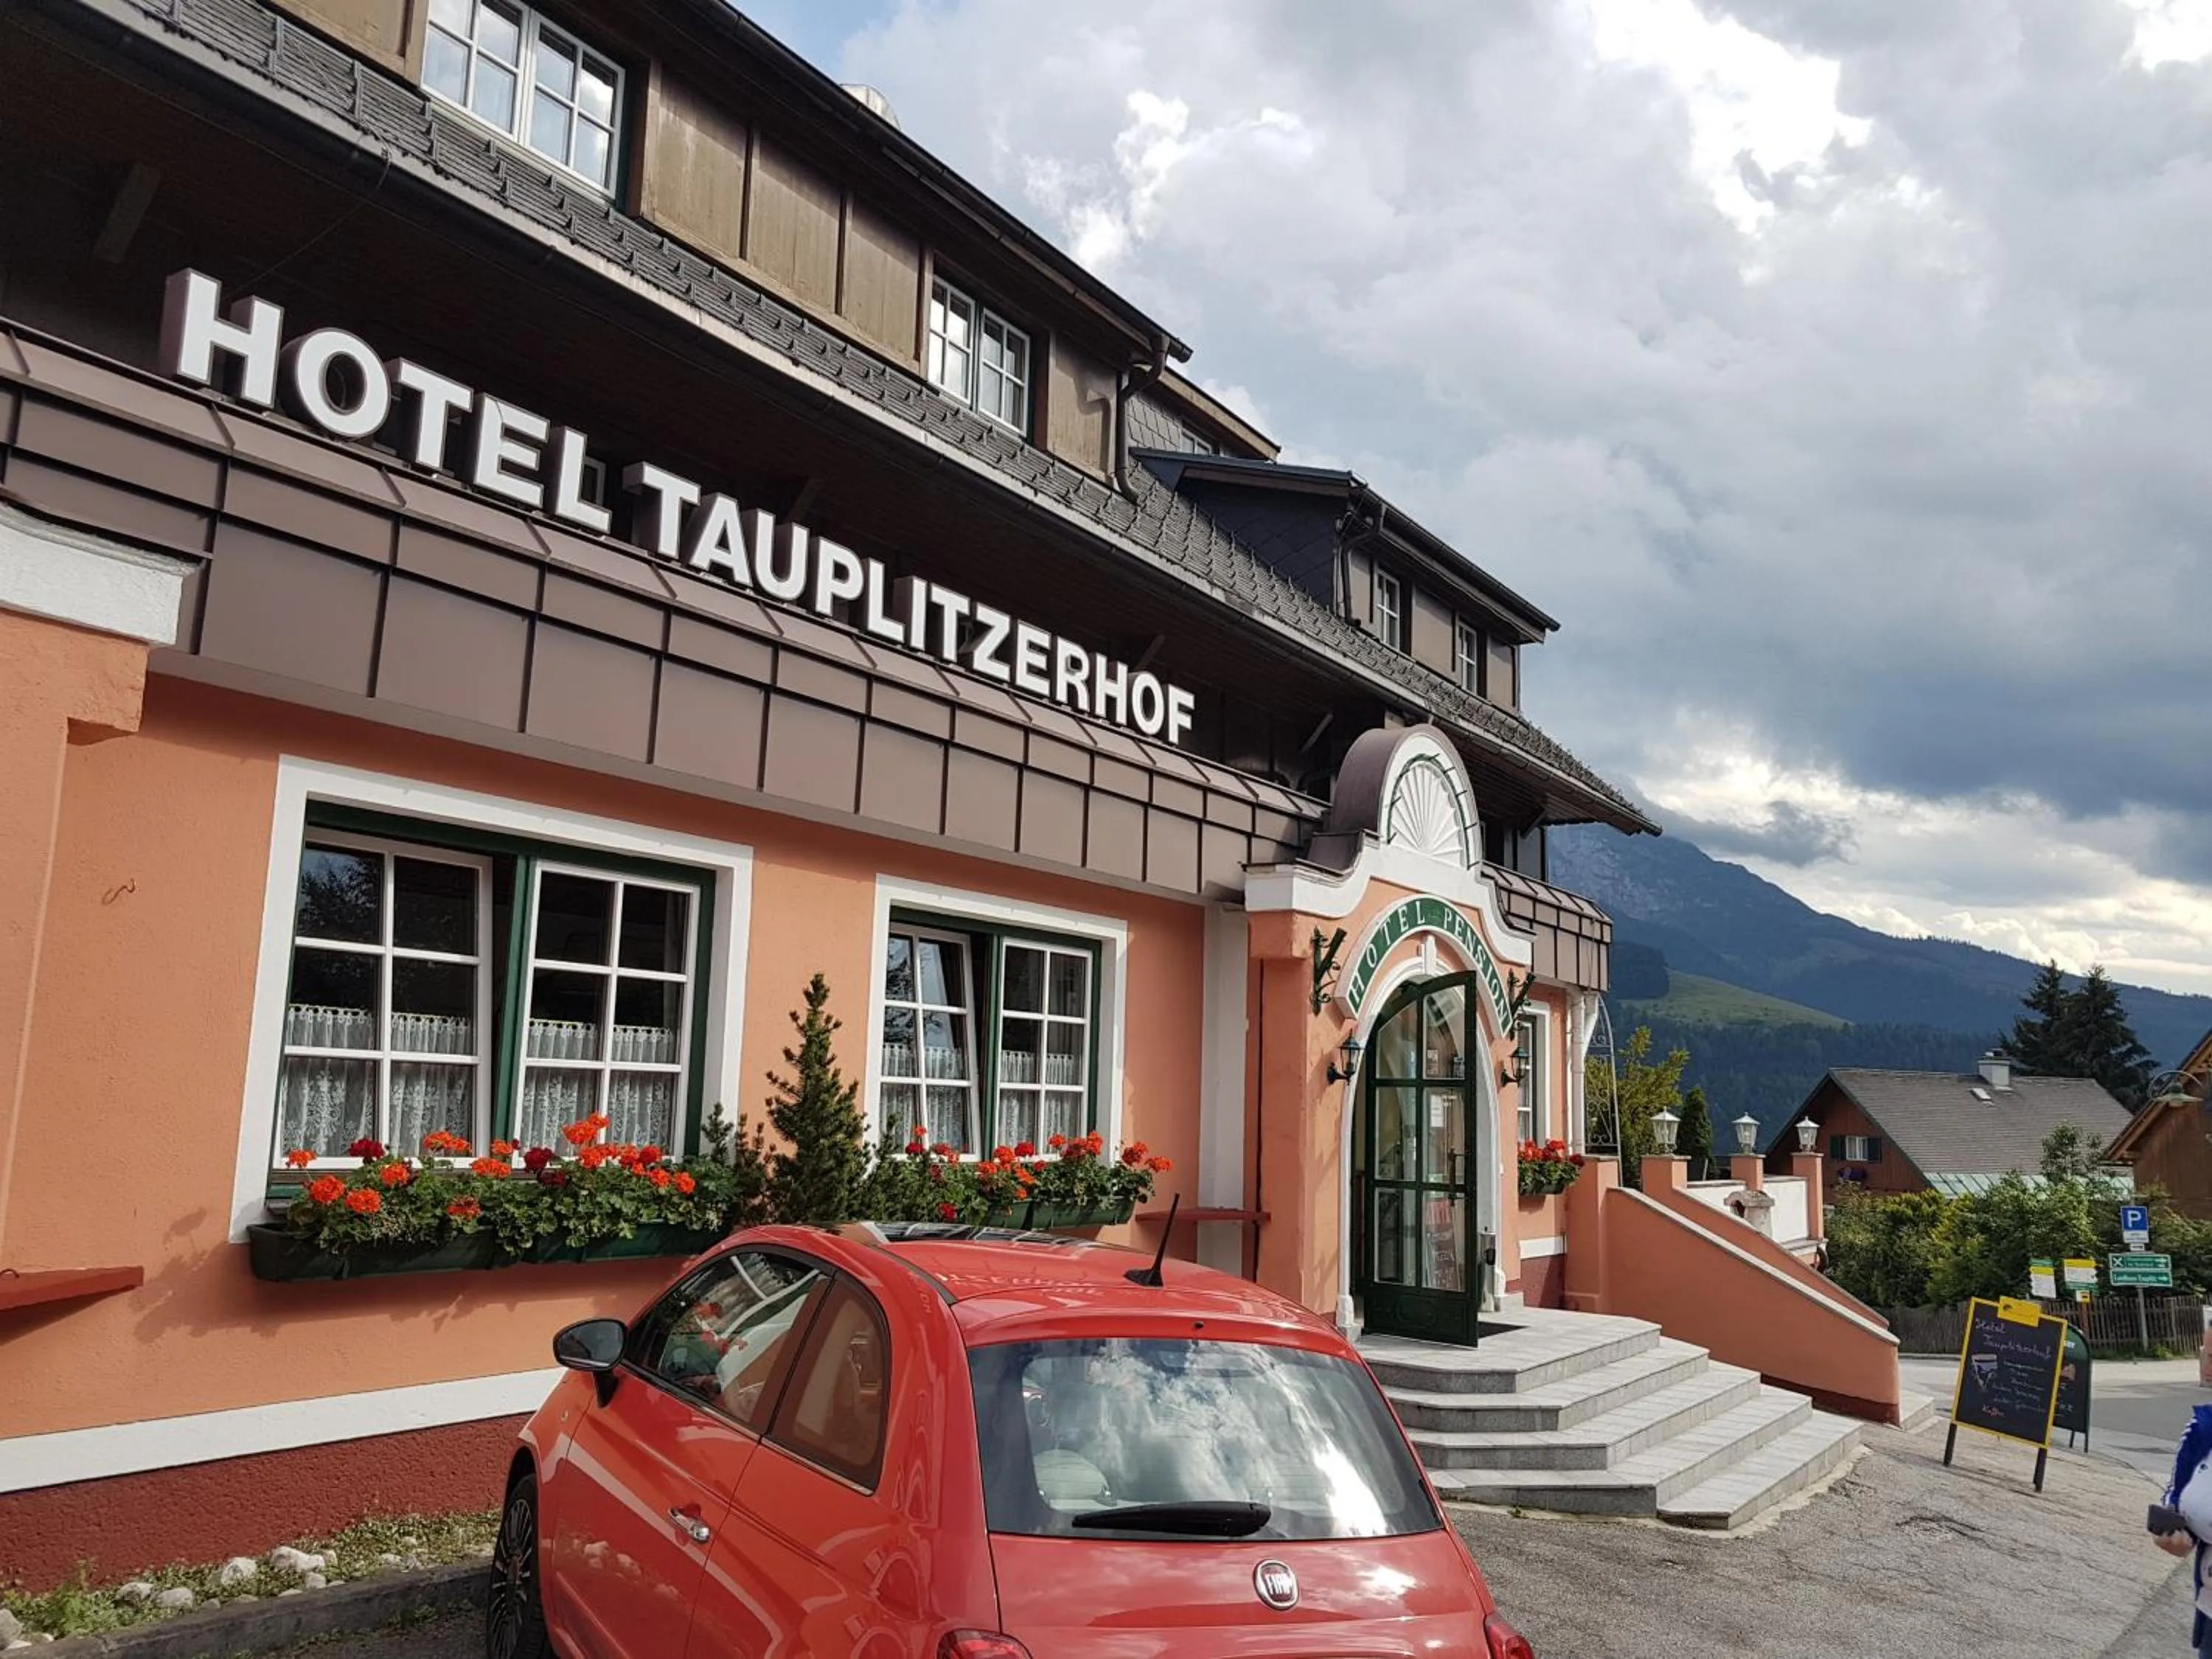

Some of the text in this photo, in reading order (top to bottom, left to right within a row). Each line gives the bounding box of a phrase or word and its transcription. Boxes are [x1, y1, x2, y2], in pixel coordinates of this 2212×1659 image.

[175, 270, 1197, 745] HOTEL TAUPLITZERHOF
[1349, 900, 1509, 1027] HOTEL PENSION
[2127, 1210, 2142, 1228] P
